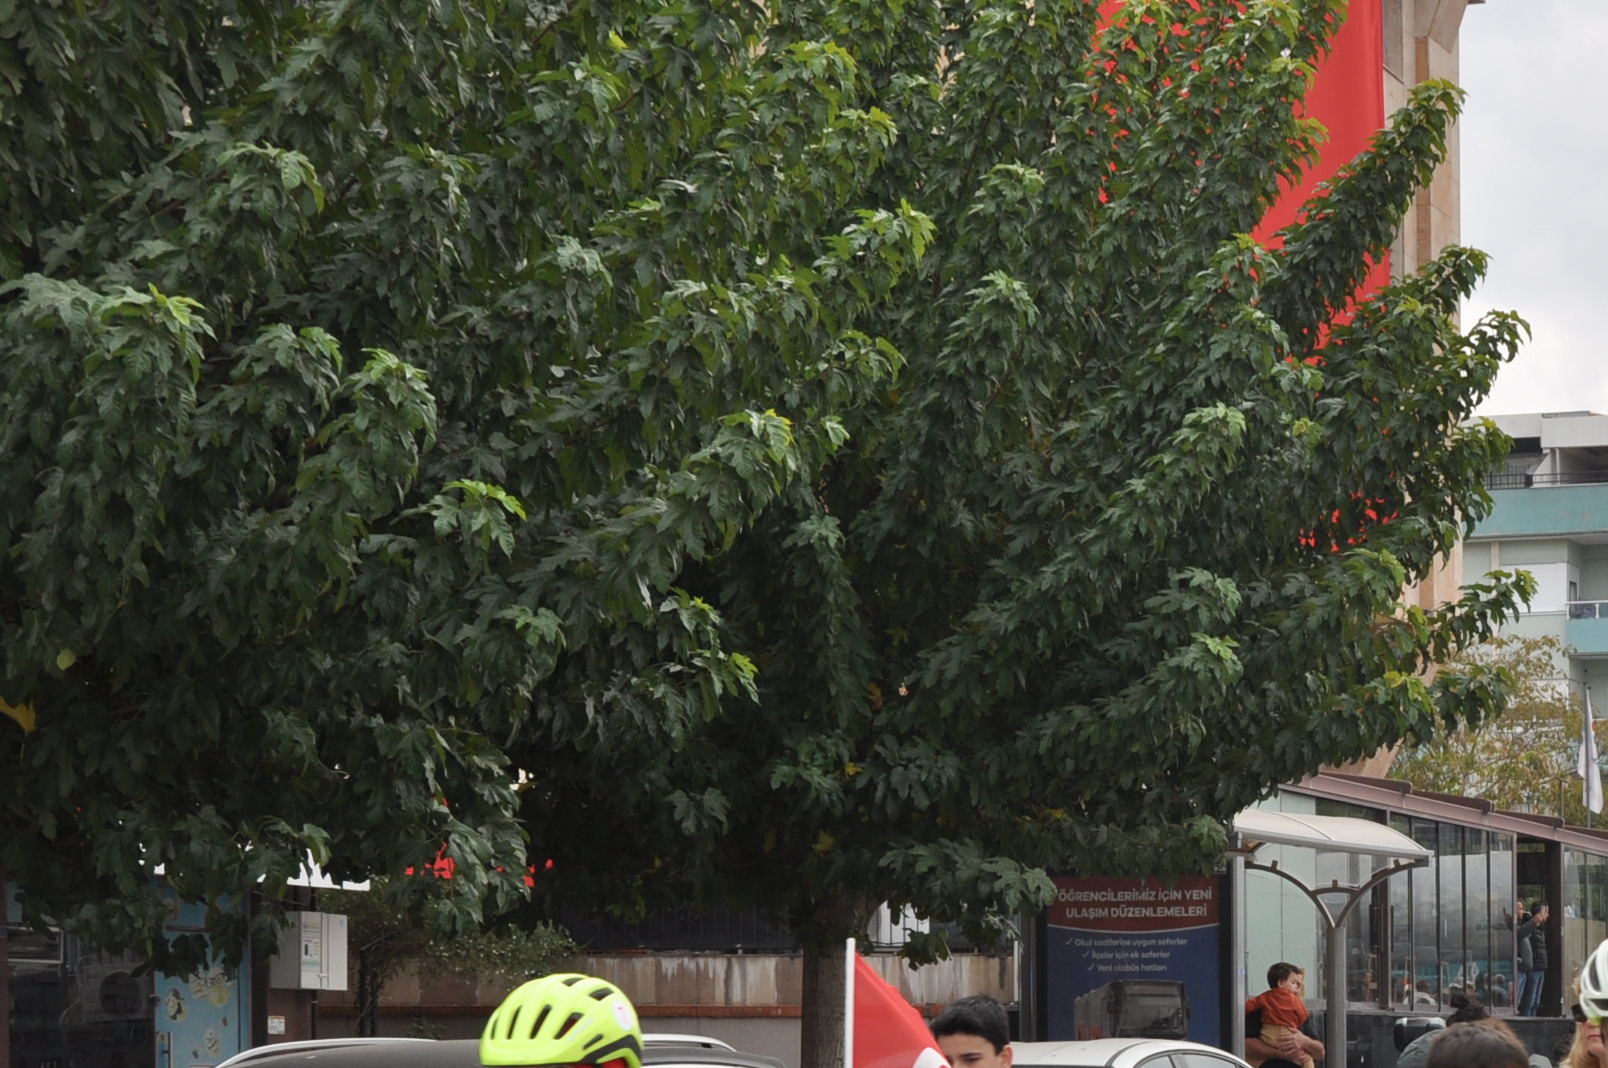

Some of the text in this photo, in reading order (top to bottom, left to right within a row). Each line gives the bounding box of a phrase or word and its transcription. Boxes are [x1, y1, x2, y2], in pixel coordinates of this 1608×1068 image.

[1058, 886, 1212, 902] ÖĞRENCİLERİMİZ İÇİN YENİ
[1066, 903, 1207, 920] ULAŞIM DÜZENLEMELERİ
[1074, 937, 1188, 948] Okul saatlerine uygun seferler
[1091, 950, 1170, 960] İlçeler için ek seferler
[1097, 963, 1167, 972] Yeni otobüs hatları
